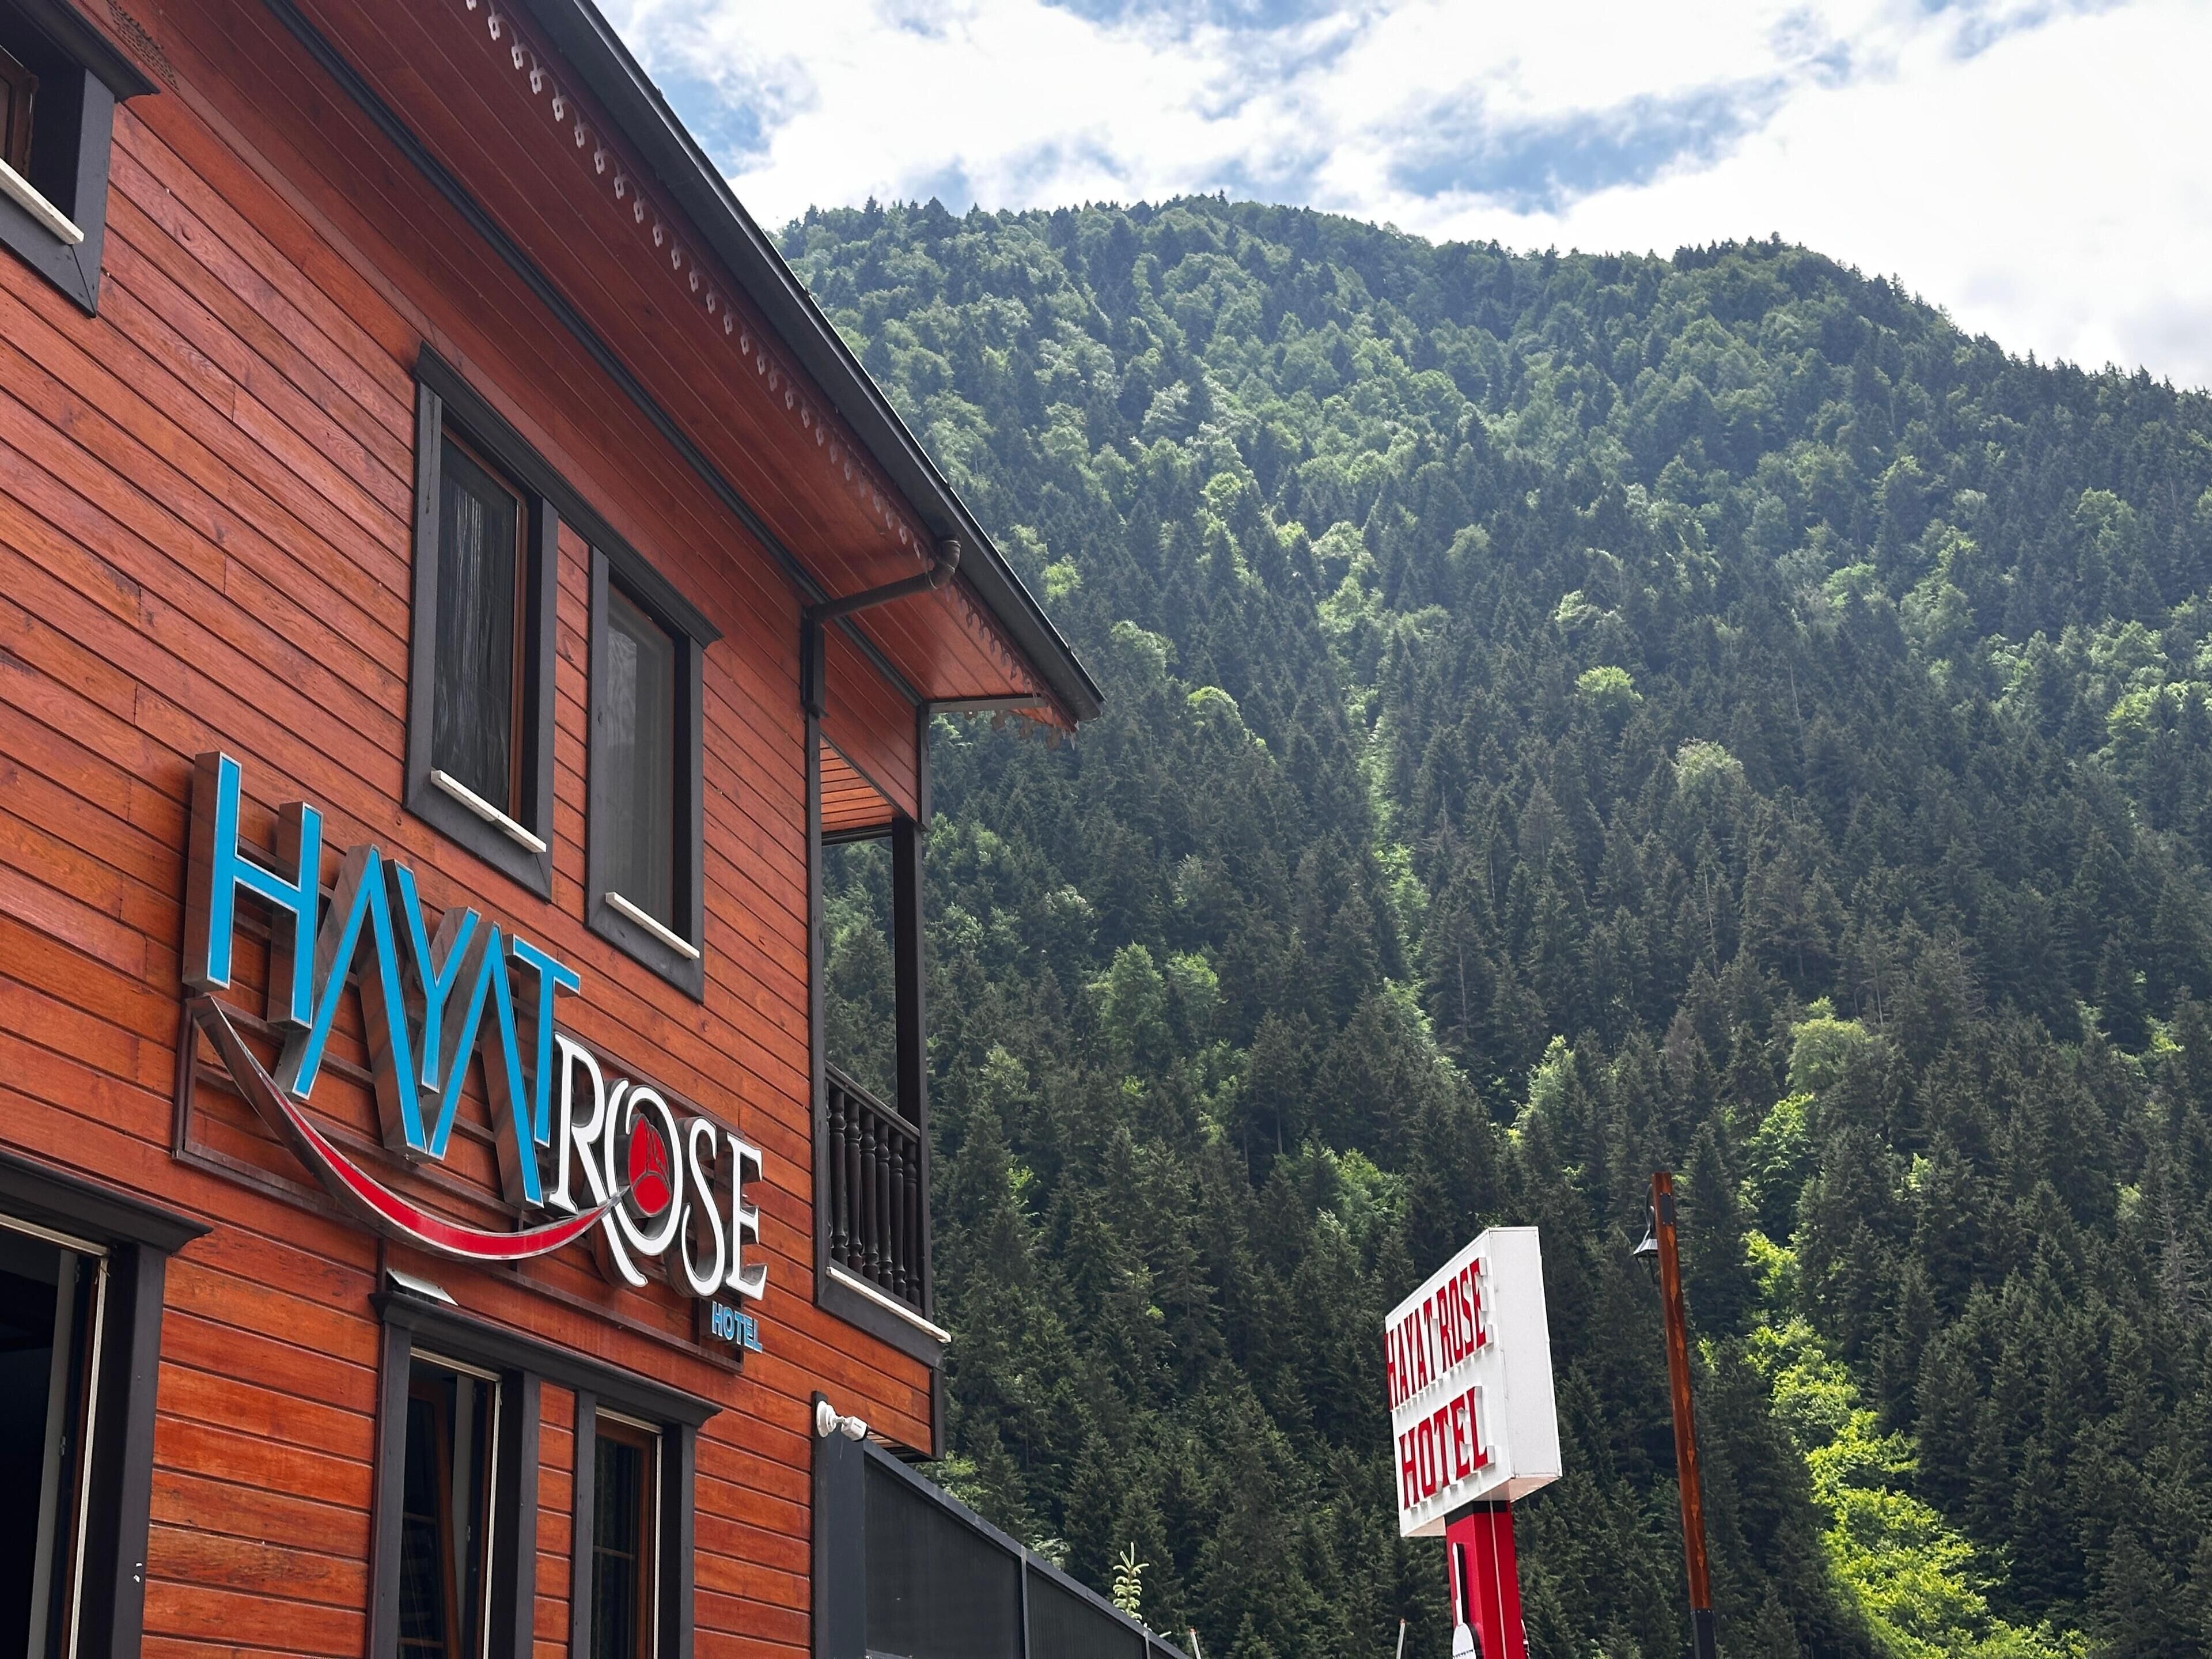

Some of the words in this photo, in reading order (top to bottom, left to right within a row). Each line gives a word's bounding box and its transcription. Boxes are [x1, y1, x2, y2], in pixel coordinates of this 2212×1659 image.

[204, 751, 581, 1209] HAYAT
[548, 1031, 767, 1300] ROSE
[711, 1300, 763, 1354] HOTEL
[1384, 1297, 1436, 1411] HAYAT
[1436, 1257, 1487, 1373] ROSE
[1399, 1387, 1488, 1510] HOTEL
